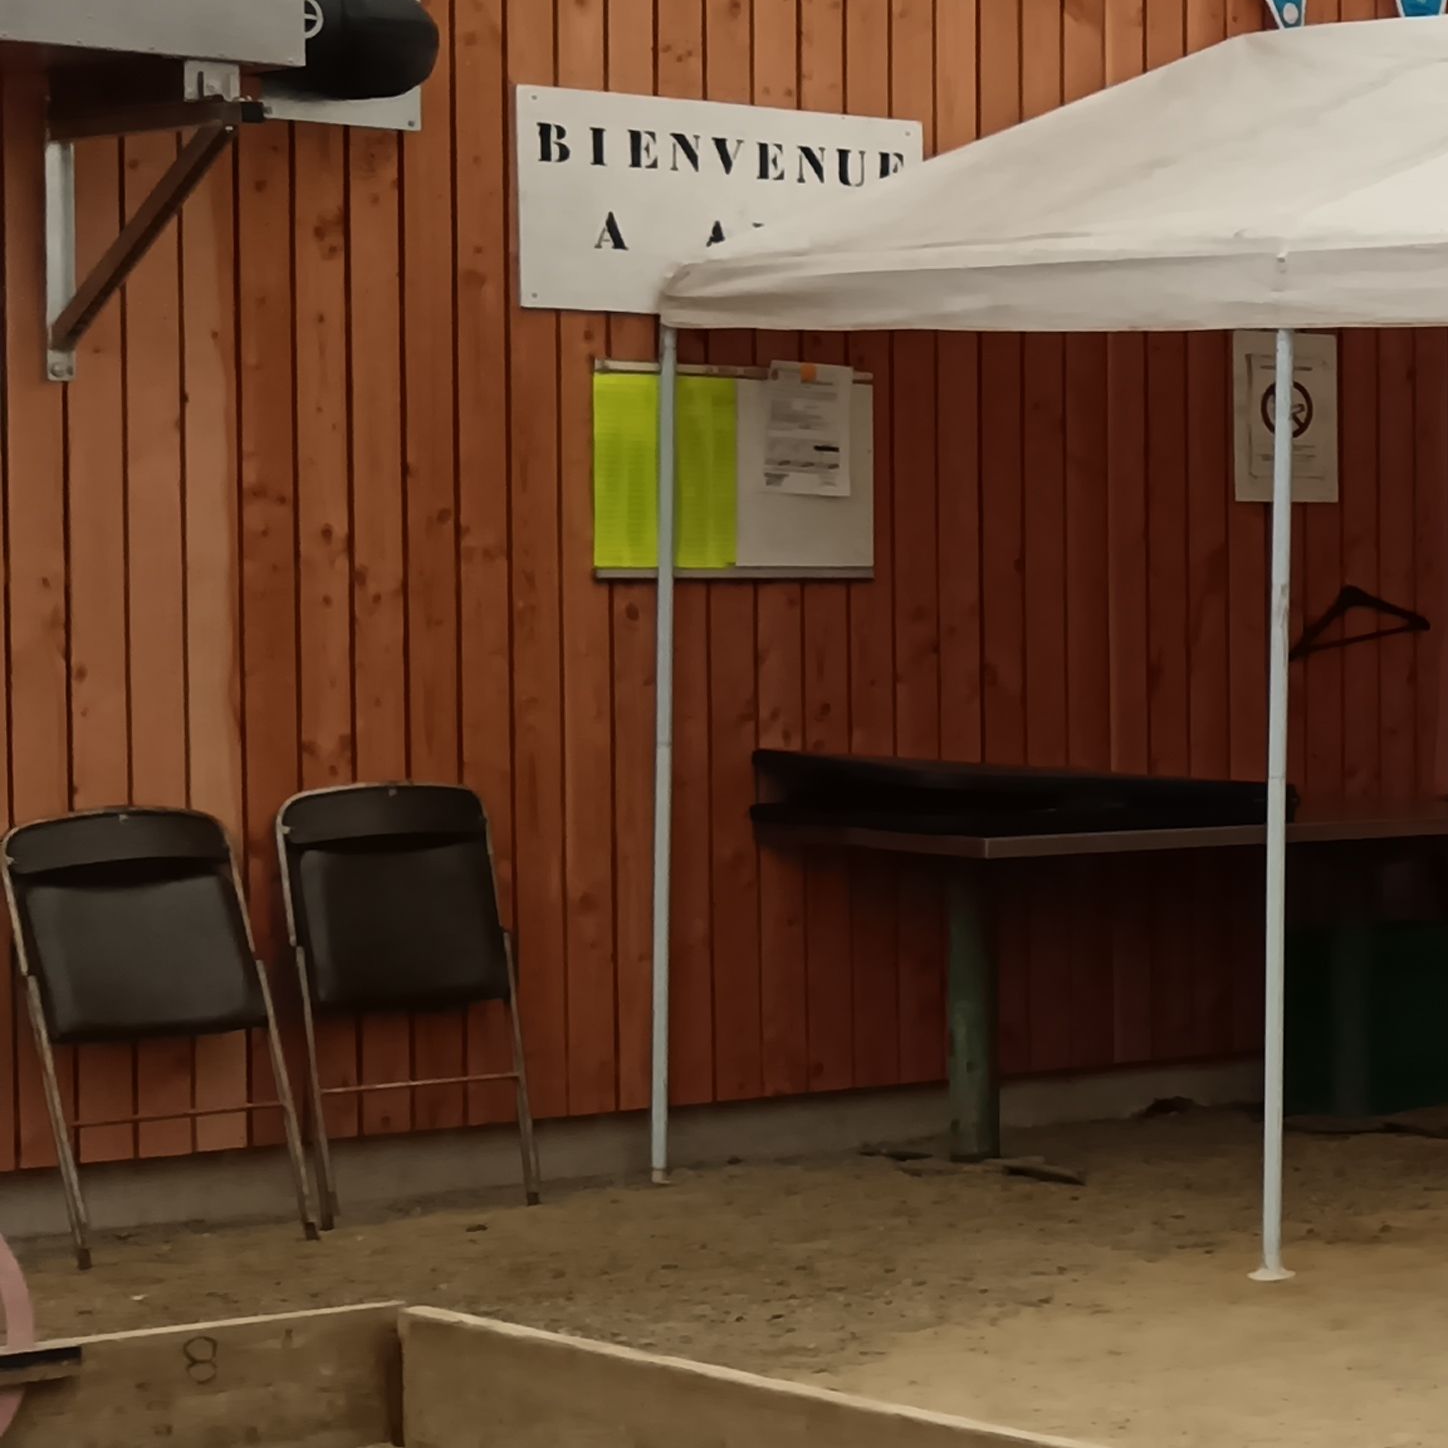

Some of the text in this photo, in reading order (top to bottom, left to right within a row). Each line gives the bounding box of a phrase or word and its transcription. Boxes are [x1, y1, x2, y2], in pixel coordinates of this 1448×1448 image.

[536, 121, 905, 187] BIENVENUE
[594, 211, 629, 251] A
[183, 1335, 218, 1385] 8
